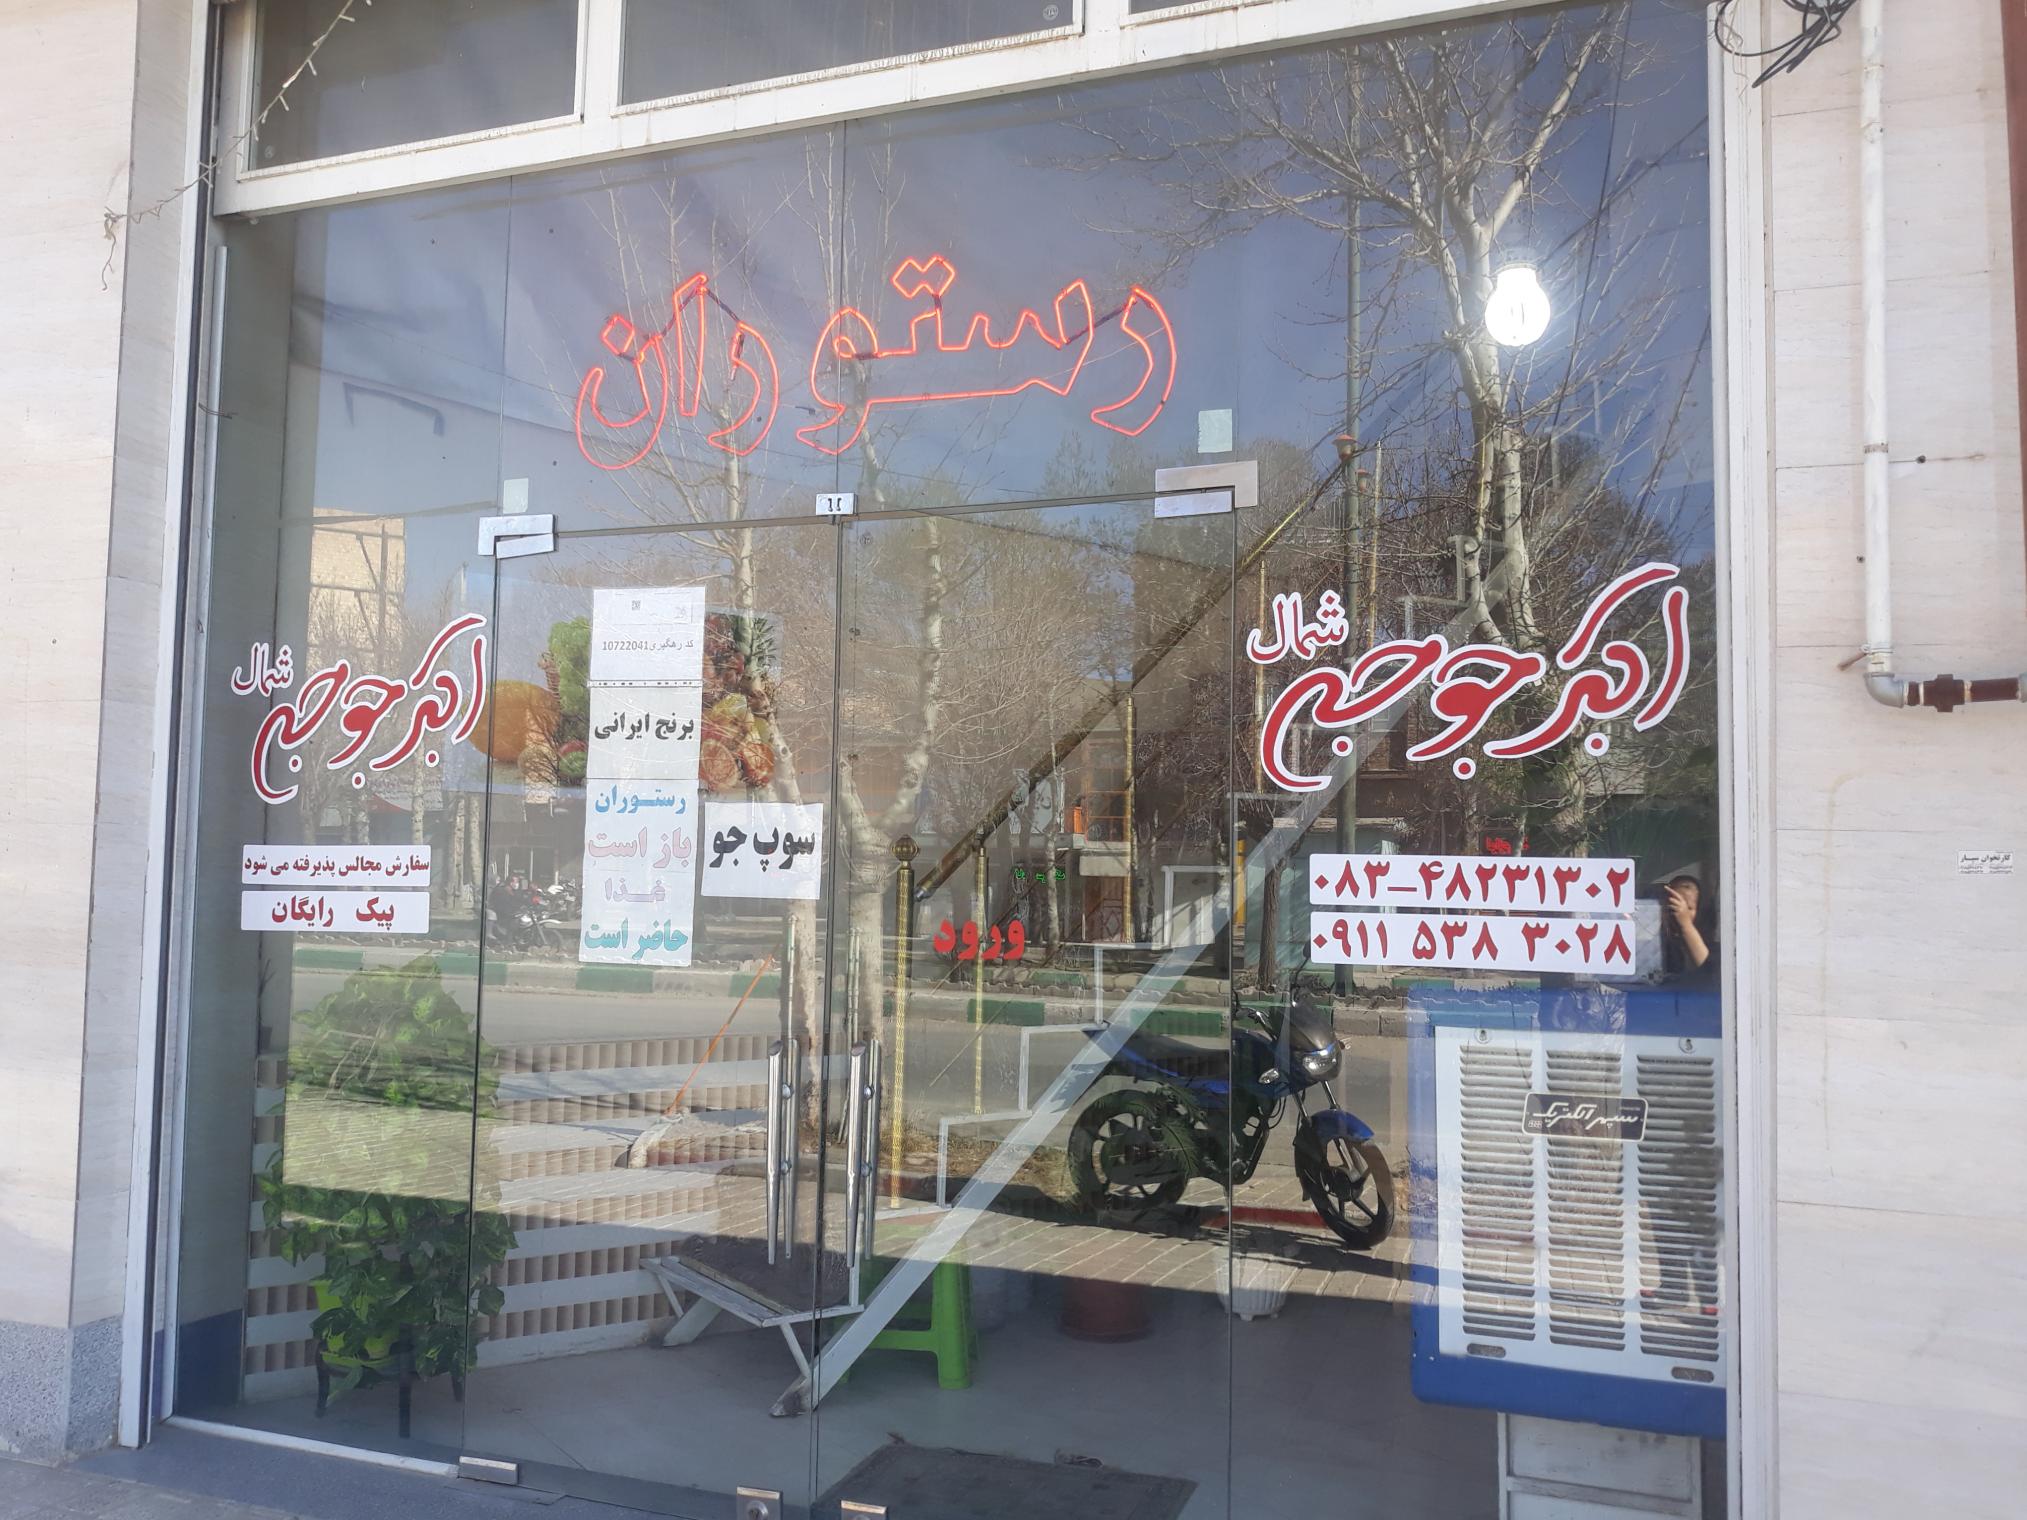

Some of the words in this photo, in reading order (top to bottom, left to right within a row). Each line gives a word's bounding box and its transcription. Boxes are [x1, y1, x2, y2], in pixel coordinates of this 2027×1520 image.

[575, 255, 1177, 470] رستوران
[1247, 590, 1349, 664] شمال
[232, 642, 293, 696] شمال
[1484, 562, 1690, 759] اکبر
[370, 613, 487, 770] اکبر
[251, 659, 407, 803] جوجه
[594, 712, 650, 741] ایرانی
[655, 714, 694, 741] برنج
[1260, 634, 1546, 792] جوجه
[594, 785, 686, 815] رستوران
[588, 827, 647, 859] است
[653, 828, 692, 869] باز
[709, 824, 748, 868] جو
[753, 826, 815, 872] سوپ
[244, 855, 267, 875] شود
[293, 854, 335, 877] پذیرفته
[338, 856, 382, 876] مجالس
[385, 854, 430, 877] سفارش
[271, 895, 334, 928] رایگان
[604, 878, 667, 904] غذا
[356, 896, 395, 931] پیک
[585, 917, 629, 949] است
[632, 917, 689, 960] حاضر
[933, 918, 1025, 960] ورود
[1313, 918, 1388, 960] ۰۹۱۱
[1412, 920, 1499, 961] ۵۳۸
[1522, 921, 1632, 965] ۳۰۲۸
